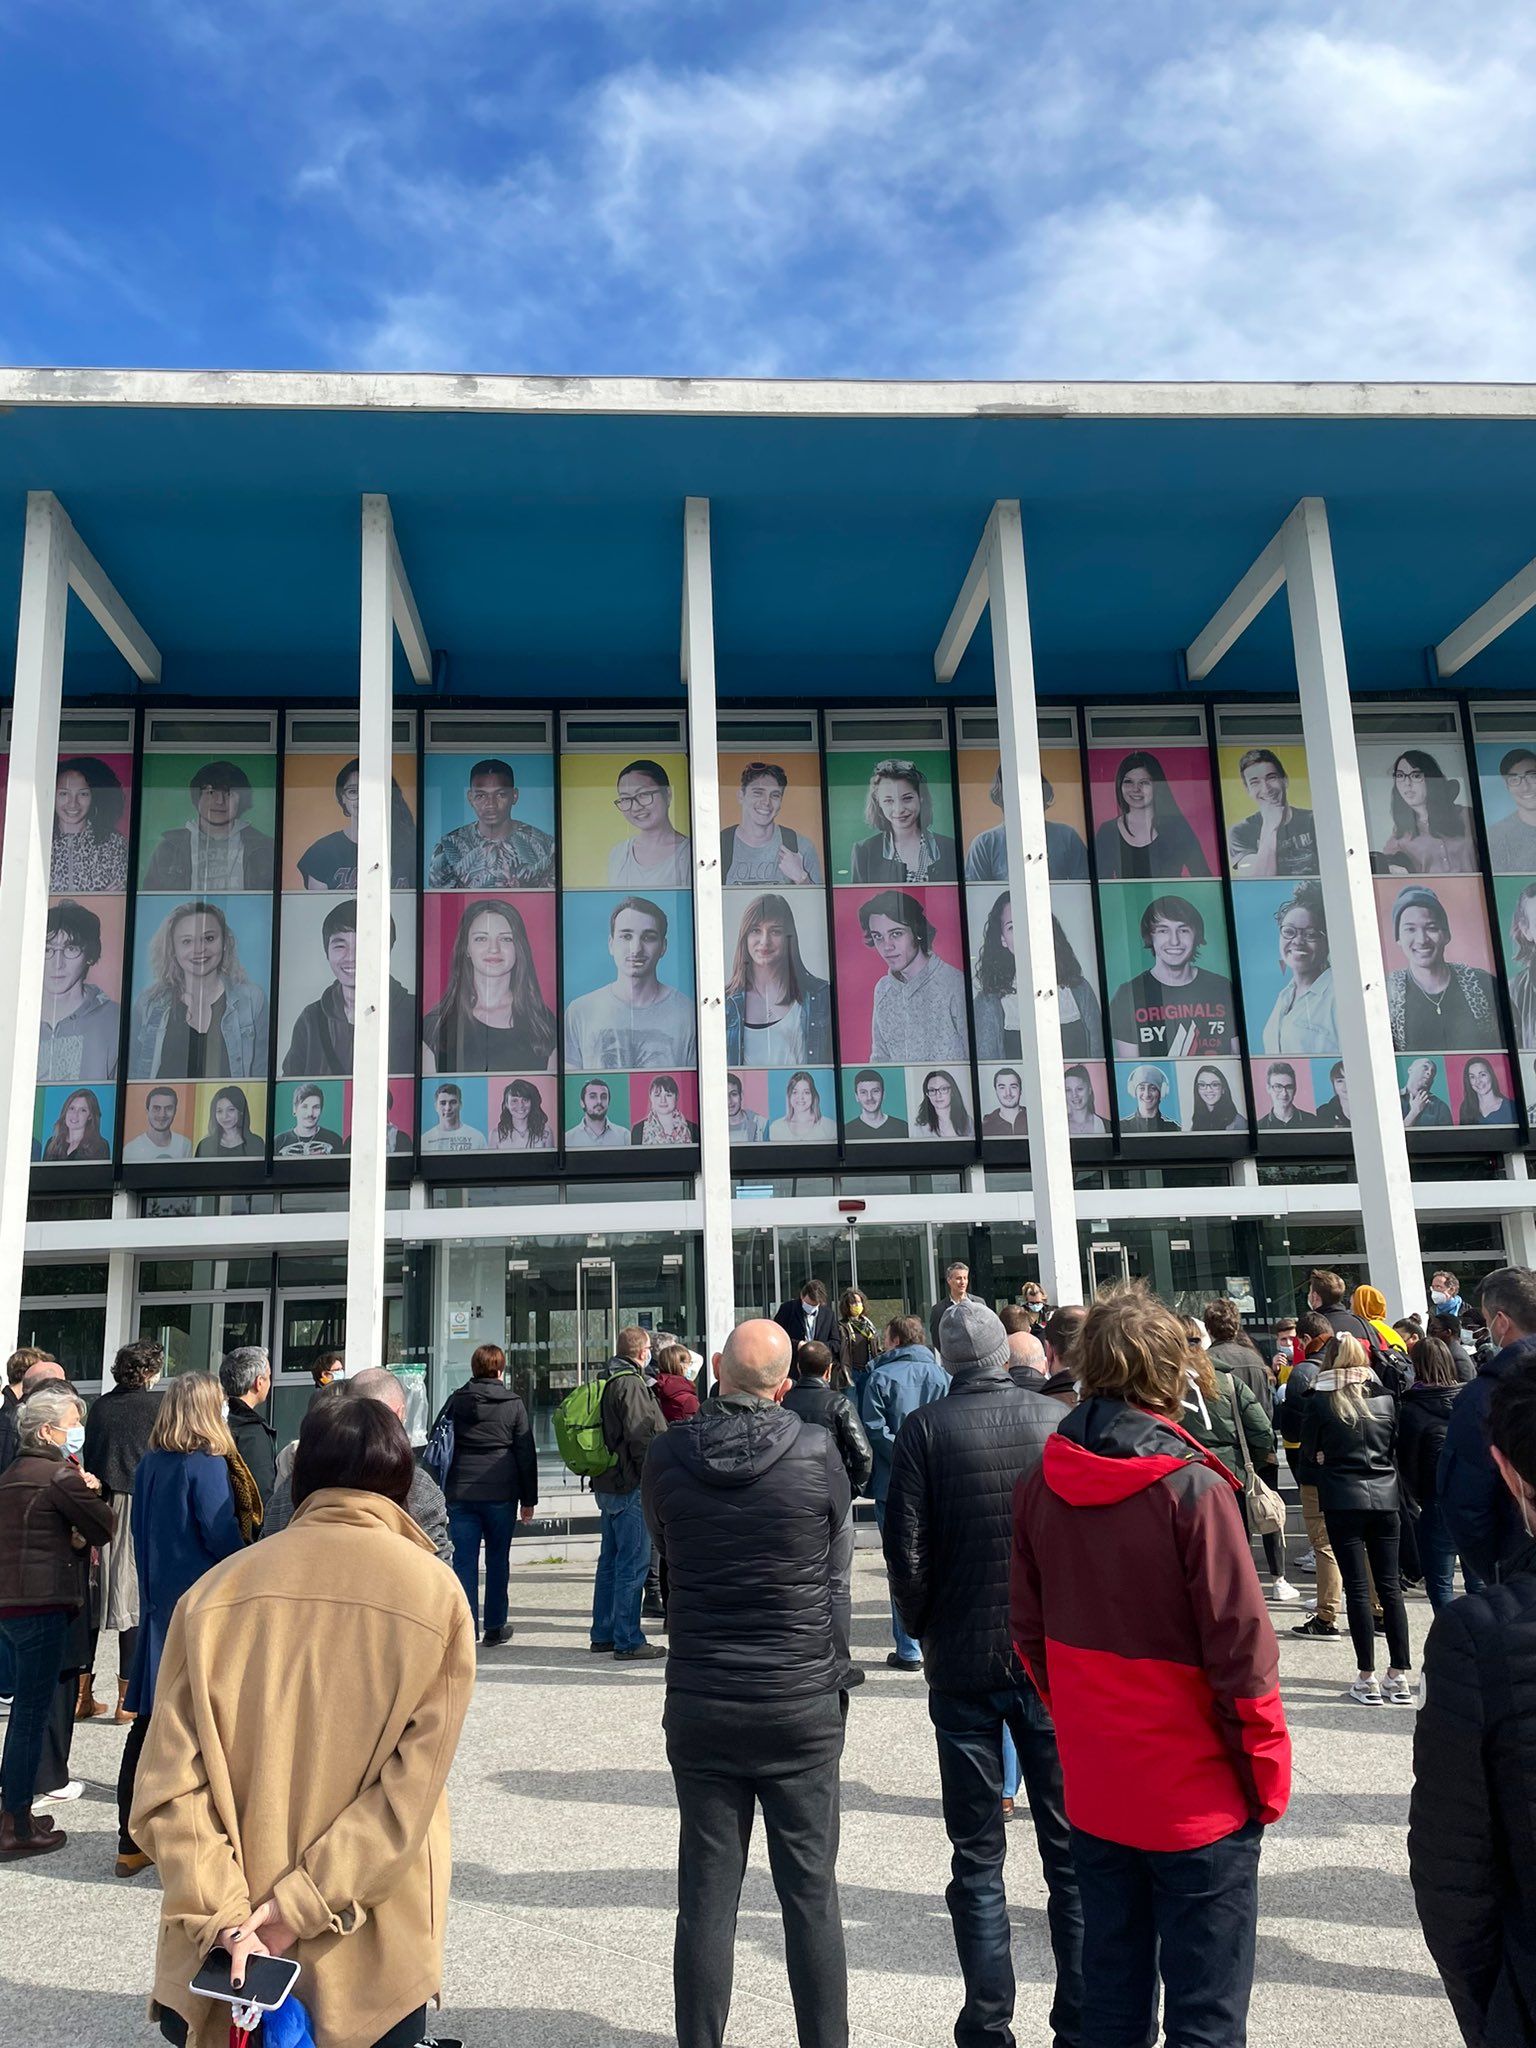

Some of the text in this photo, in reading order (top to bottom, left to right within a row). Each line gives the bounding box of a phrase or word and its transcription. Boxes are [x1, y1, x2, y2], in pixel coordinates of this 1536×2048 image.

[1136, 1003, 1225, 1023] ORIGINALS
[1139, 1021, 1225, 1043] BY 75
